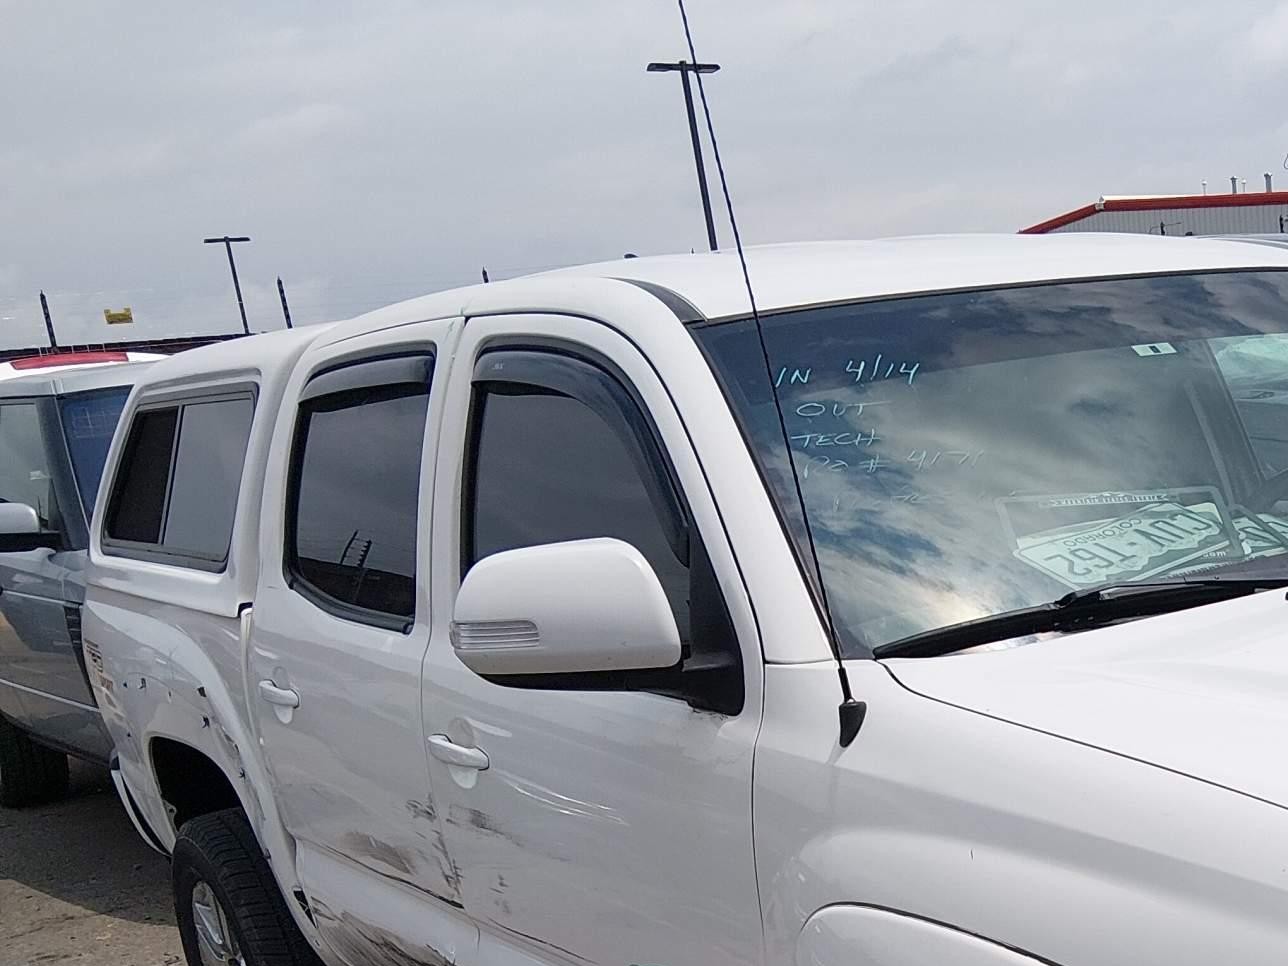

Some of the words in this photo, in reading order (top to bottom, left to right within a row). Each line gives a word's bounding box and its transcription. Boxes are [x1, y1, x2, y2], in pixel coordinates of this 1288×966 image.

[774, 367, 812, 388] IN
[845, 353, 921, 385] 4/14
[795, 399, 893, 418] OUT
[790, 428, 882, 448] TECH
[1062, 517, 1143, 547] COLORADO
